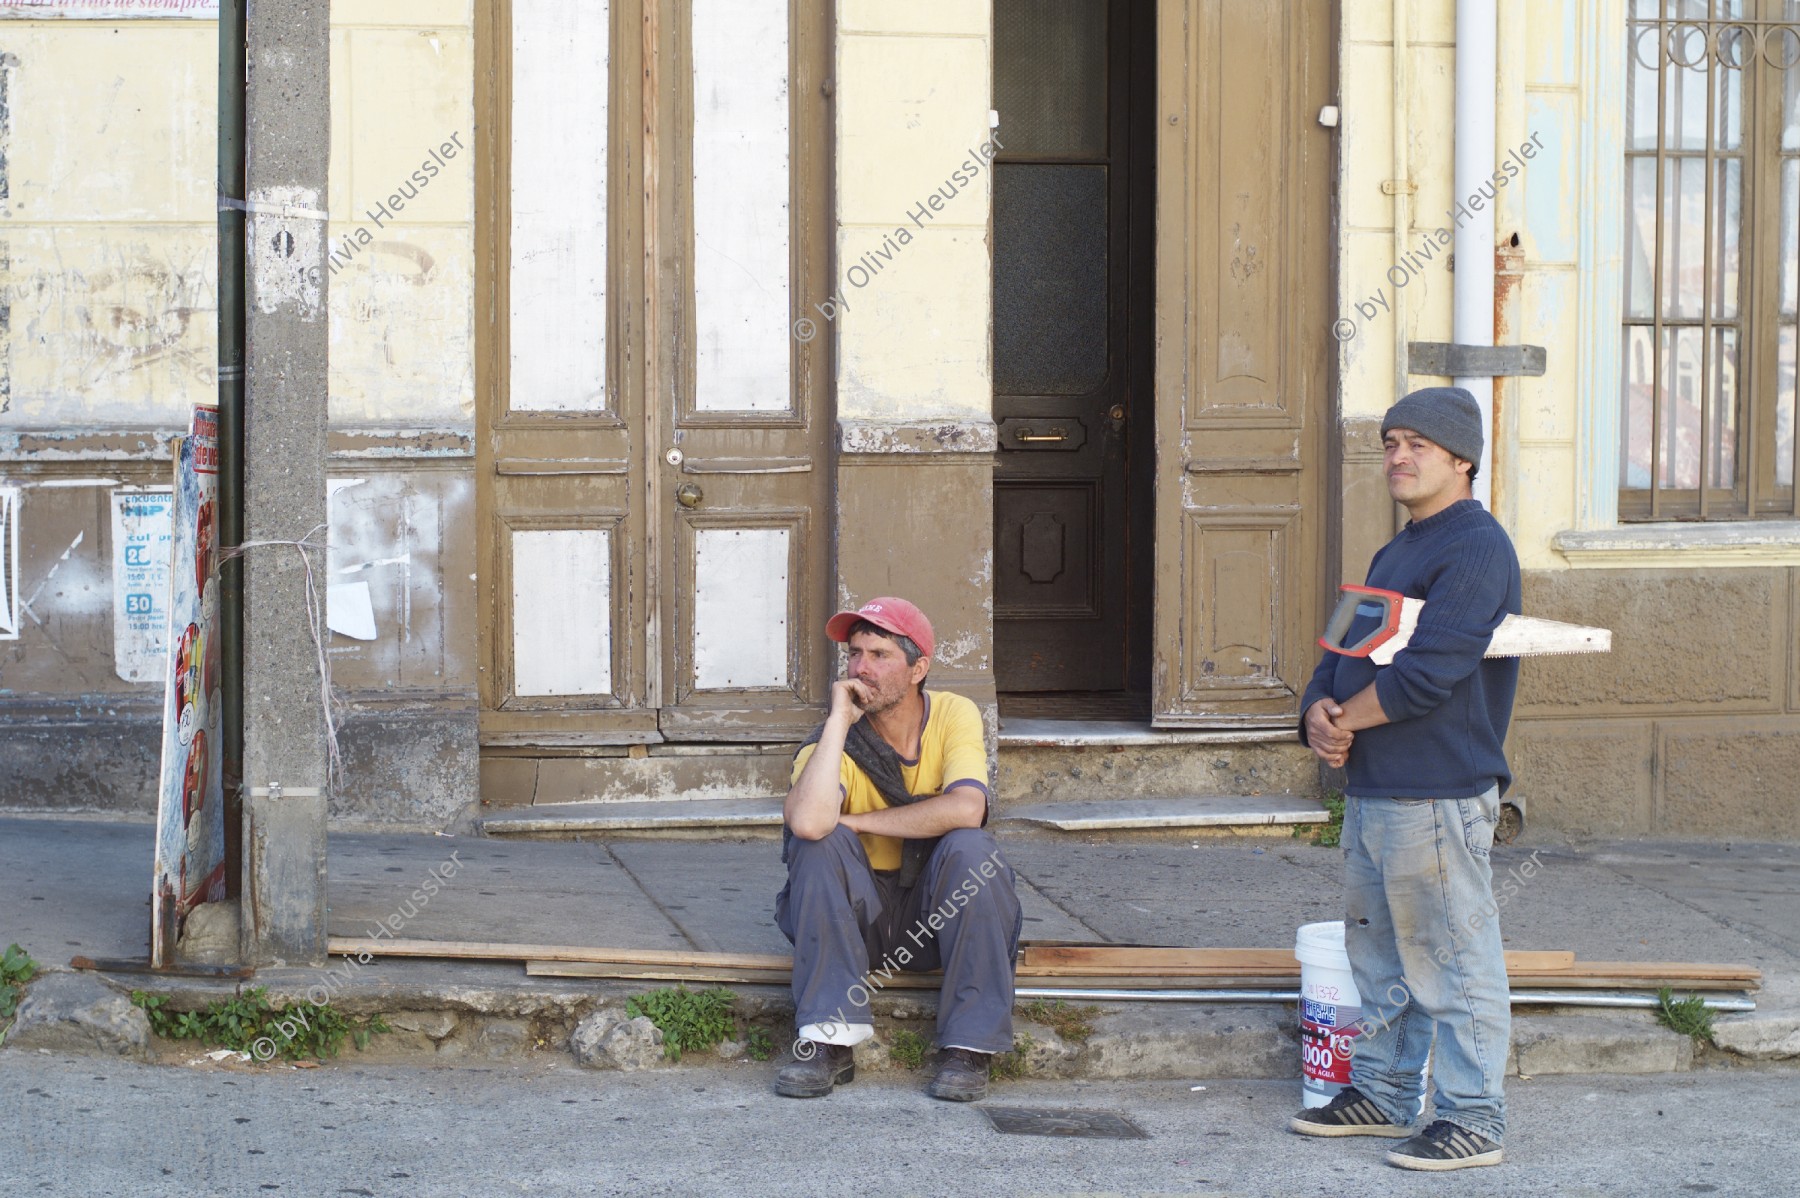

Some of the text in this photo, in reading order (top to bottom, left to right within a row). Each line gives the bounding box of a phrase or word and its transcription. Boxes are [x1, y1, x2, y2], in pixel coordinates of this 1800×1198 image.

[195, 443, 207, 466] de
[128, 596, 150, 612] 30
[1317, 1026, 1353, 1050] Pro
[1302, 1041, 1333, 1069] 000
